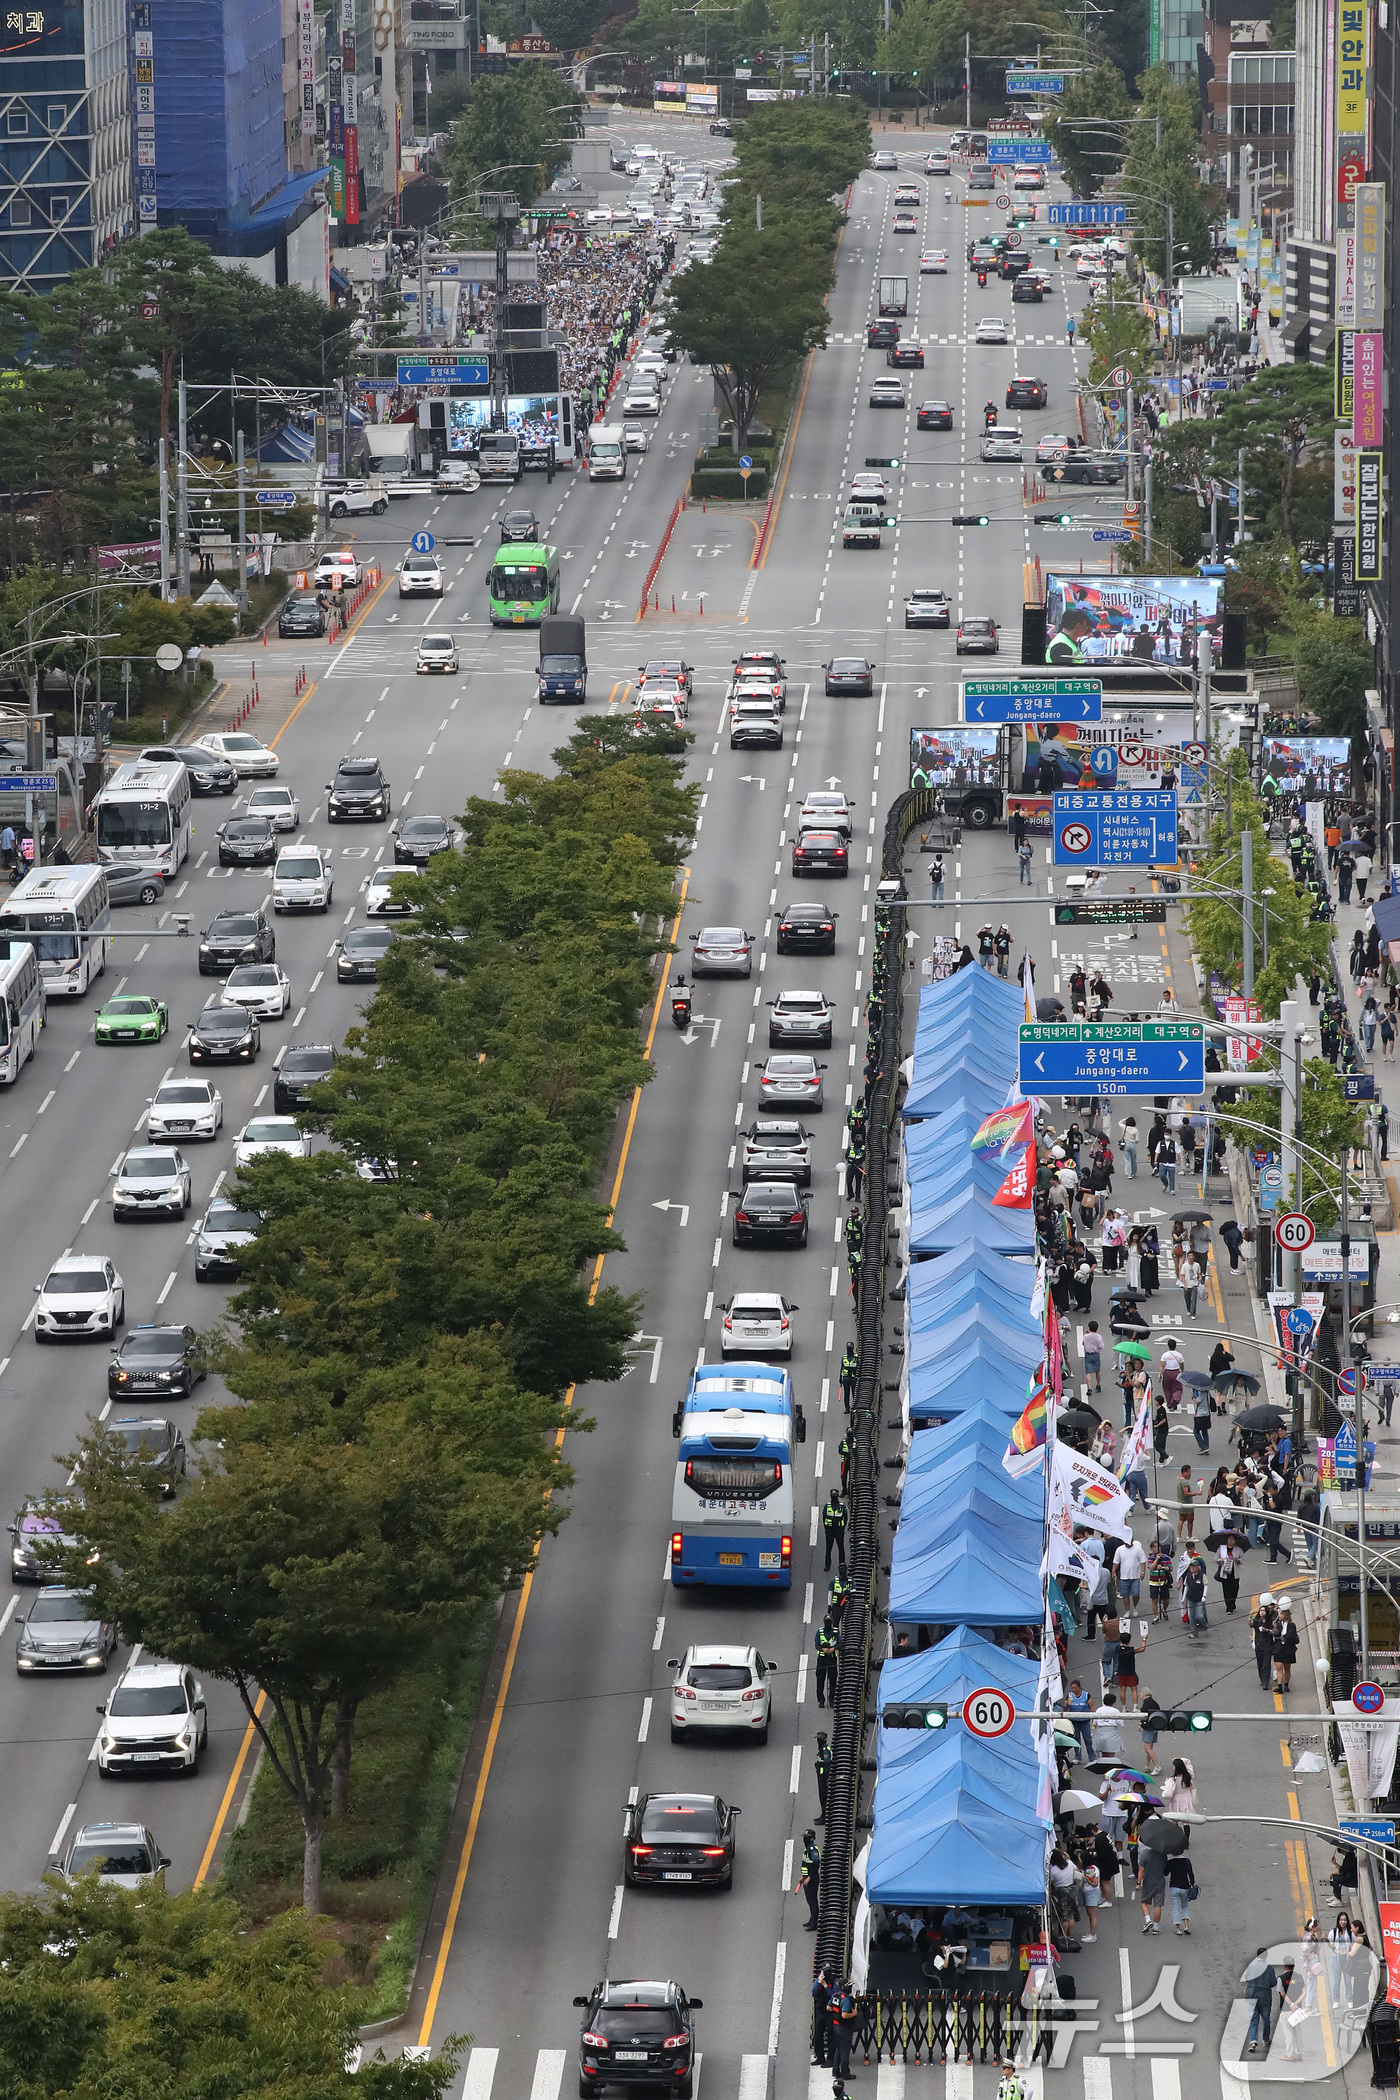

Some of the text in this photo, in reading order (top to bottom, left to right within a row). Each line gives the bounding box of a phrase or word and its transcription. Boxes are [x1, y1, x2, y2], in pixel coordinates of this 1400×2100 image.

[6, 12, 44, 33] 치과
[303, 13, 312, 54] 뷰티라인
[1341, 0, 1364, 90] 빛안과
[302, 57, 313, 82] 치과
[140, 88, 150, 111] 하이모
[334, 166, 342, 212] SUBWAY
[1362, 338, 1375, 389] 솜씨있는
[430, 368, 456, 376] 중앙대로
[1362, 391, 1375, 440] 여성의원
[1361, 464, 1379, 520] 잘보는
[1362, 523, 1376, 569] 한의원
[1341, 539, 1354, 584] 뮤즈의원
[1145, 606, 1201, 624] 퍼이드
[1341, 606, 1353, 615] 5F
[976, 683, 1008, 692] 명덕네거리
[1021, 683, 1054, 692] 계산오거리
[1064, 683, 1091, 691] 대구역
[1014, 698, 1053, 709] 중앙대로
[1006, 711, 1060, 720] Jungang-daero
[1058, 795, 1172, 808] 대중교통전용지구
[1104, 815, 1139, 825] 시내버스
[1158, 832, 1175, 842] 허용
[1103, 839, 1149, 848] 이륜자동차
[1104, 852, 1132, 861] 자전거
[1033, 1028, 1077, 1038] 명덕네거리
[1095, 1027, 1140, 1038] 계산오거리
[1154, 1026, 1189, 1037] 대구역
[1086, 1048, 1137, 1064] 중앙대로
[1075, 1066, 1149, 1077] Jungang-daero
[1097, 1083, 1126, 1094] 150m
[1285, 1224, 1306, 1241] 60
[1305, 1258, 1365, 1267] 메트로주장
[1072, 1462, 1098, 1481] 무지개로
[699, 1500, 767, 1510] 해운대고속관광
[1369, 1524, 1400, 1535] 반월
[976, 1702, 1002, 1725] 60
